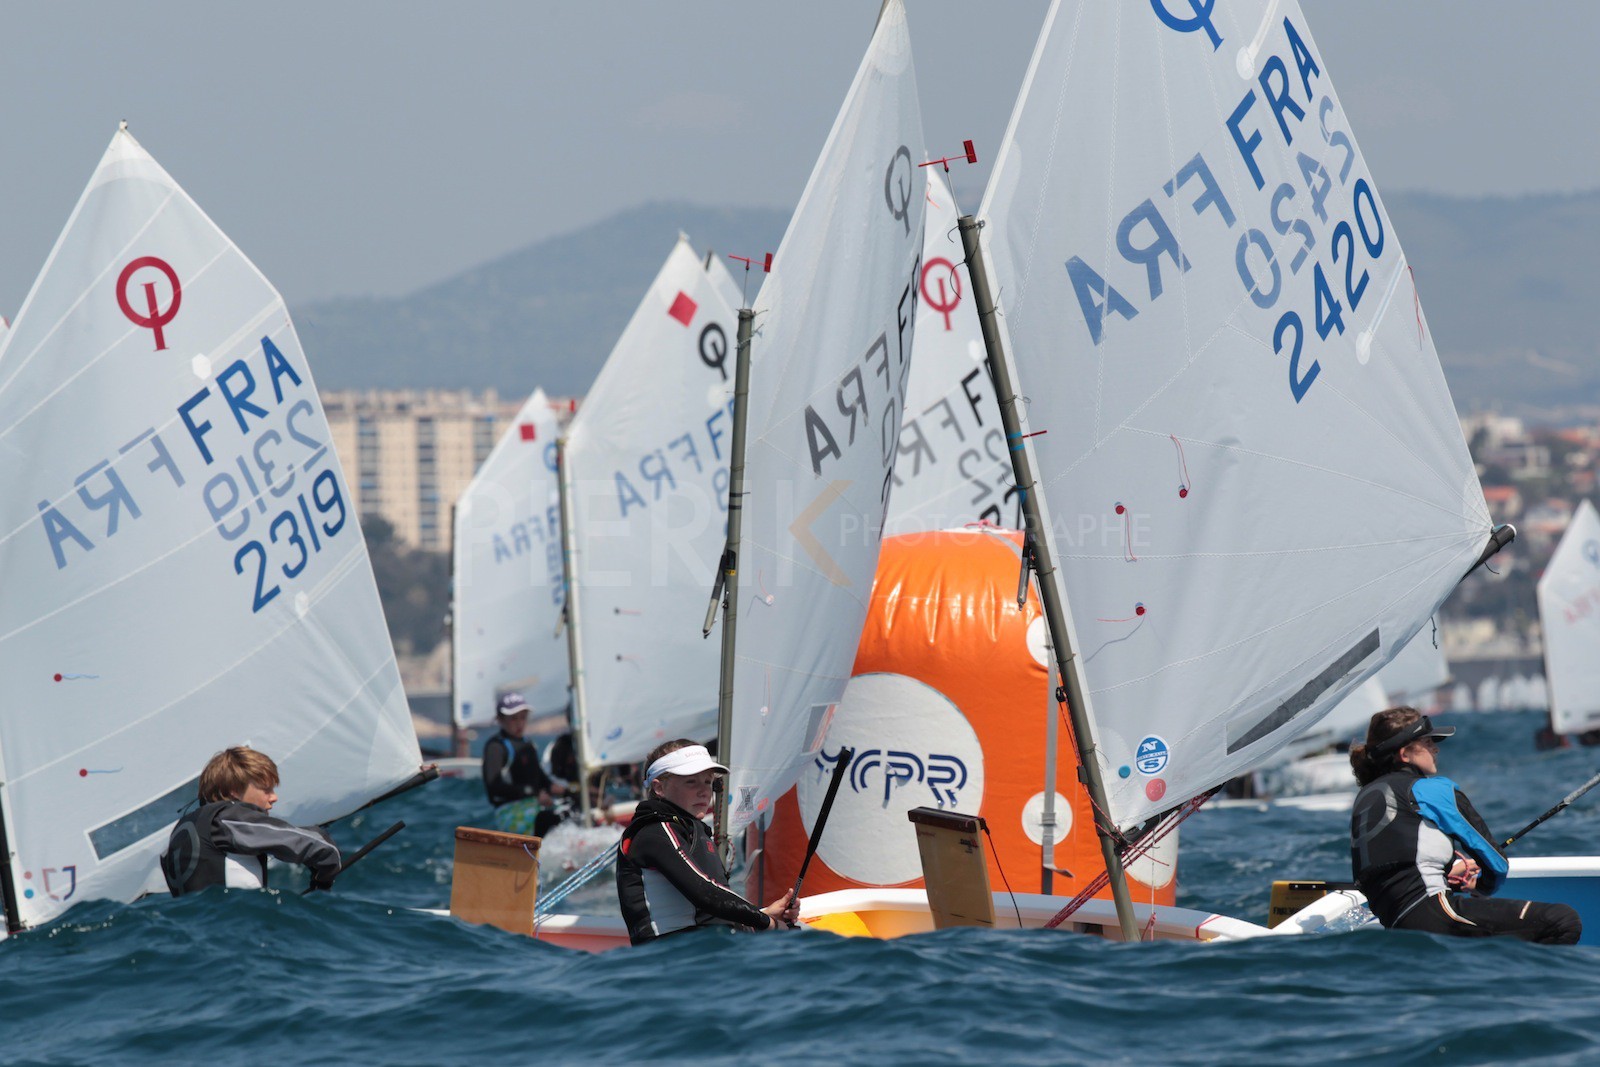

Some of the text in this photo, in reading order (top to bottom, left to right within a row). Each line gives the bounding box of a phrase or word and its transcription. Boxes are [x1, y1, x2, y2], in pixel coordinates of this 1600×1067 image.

[1225, 15, 1320, 192] FRA
[1273, 178, 1385, 404] 2420
[176, 335, 302, 466] FRA
[233, 469, 346, 614] 2319
